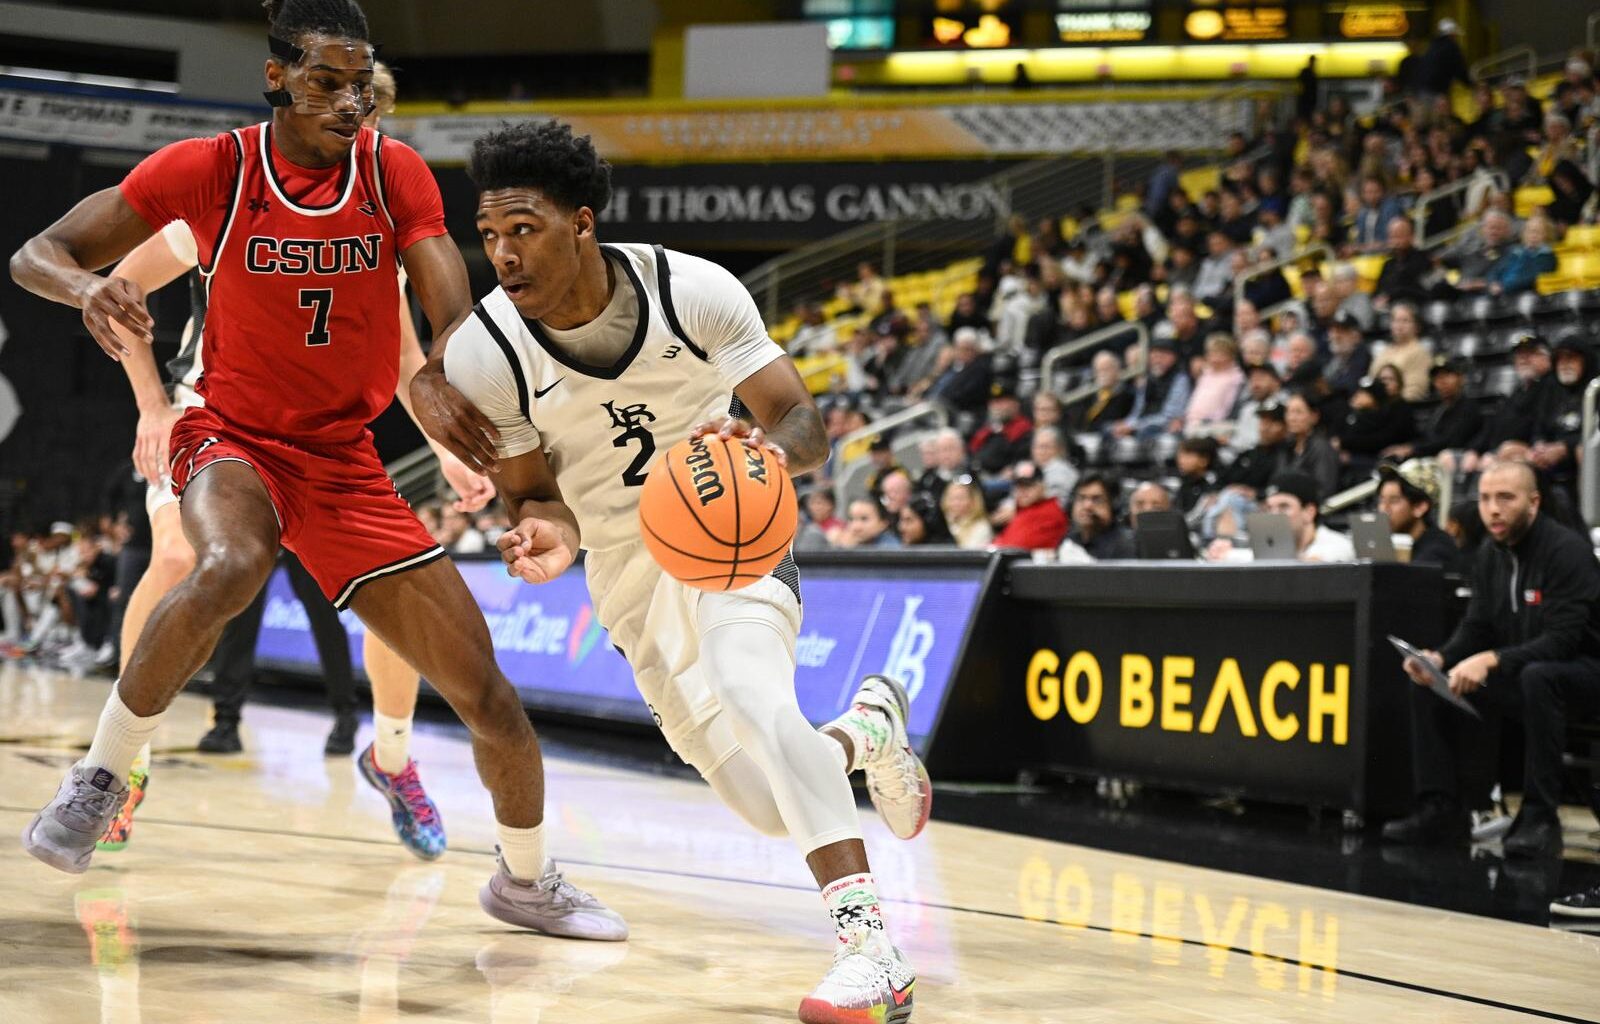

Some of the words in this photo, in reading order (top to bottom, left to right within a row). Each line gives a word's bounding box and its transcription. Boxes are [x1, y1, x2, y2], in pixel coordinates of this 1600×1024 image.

[643, 185, 816, 222] THOMAS
[826, 184, 1010, 222] GANNON
[246, 234, 382, 275] CSUN
[299, 288, 333, 346] 7
[612, 426, 656, 486] 2
[1026, 649, 1103, 724] GO
[1119, 653, 1350, 745] BEACH
